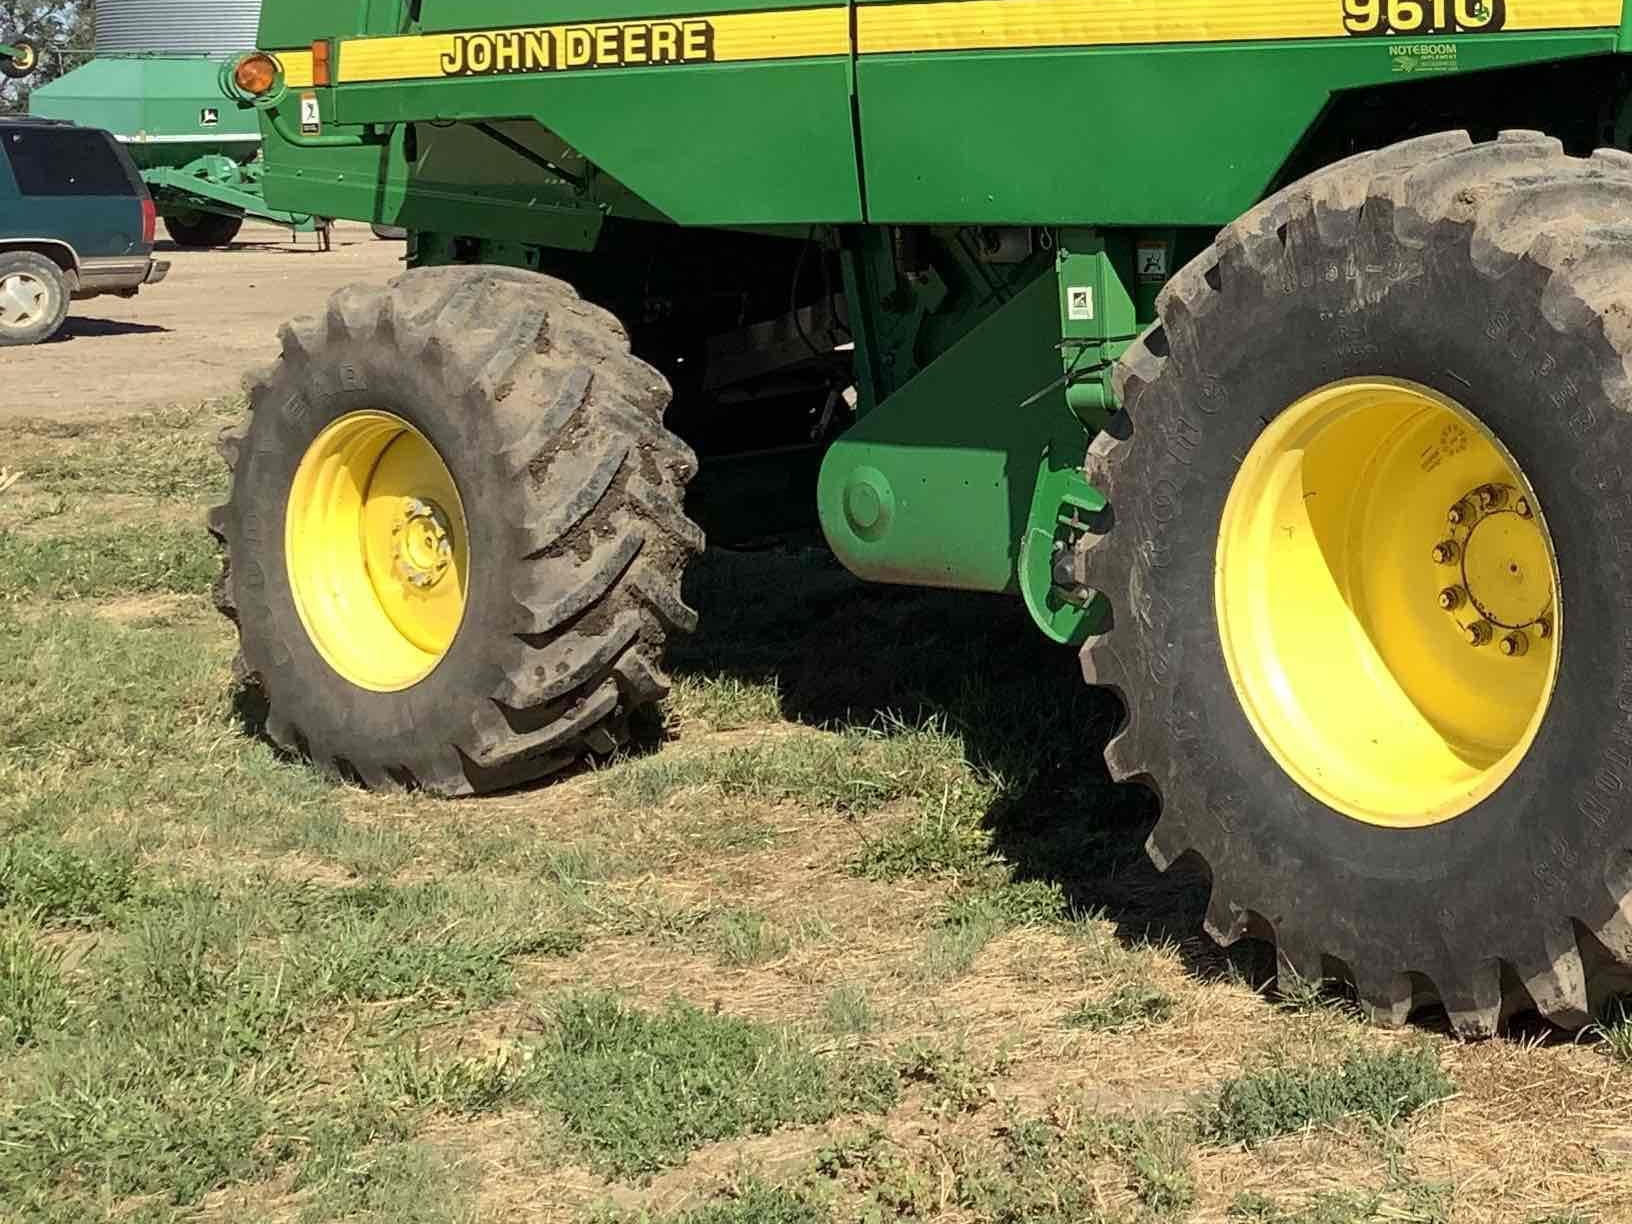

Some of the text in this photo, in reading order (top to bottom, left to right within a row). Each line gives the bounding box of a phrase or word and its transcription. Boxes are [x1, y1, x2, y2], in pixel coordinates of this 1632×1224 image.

[440, 21, 712, 74] JOHN DEERE
[1388, 43, 1457, 56] NOTEBOOM
